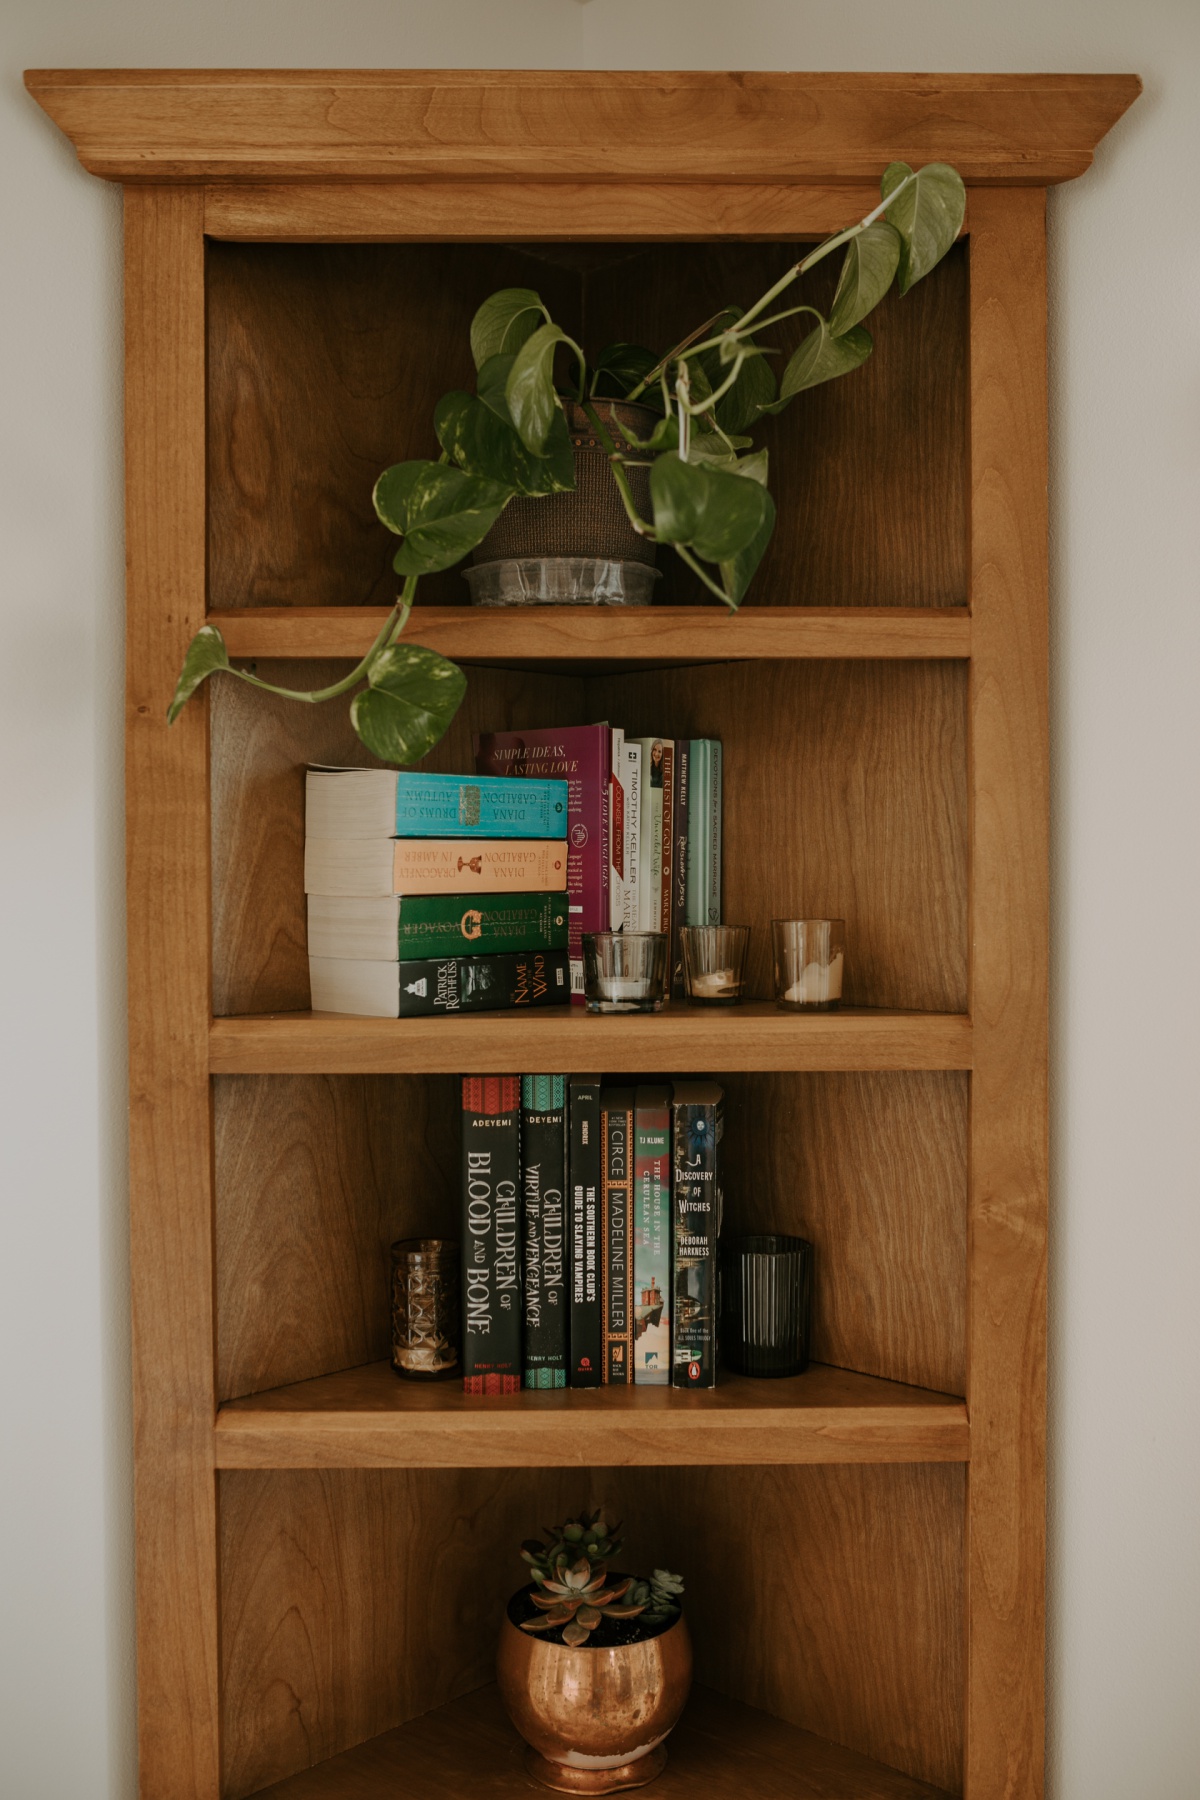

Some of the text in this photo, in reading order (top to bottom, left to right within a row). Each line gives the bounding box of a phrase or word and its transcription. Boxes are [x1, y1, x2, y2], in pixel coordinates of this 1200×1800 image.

[493, 745, 566, 760] SIMPLE IDEAS,
[505, 760, 579, 776] LASTING LOVE
[406, 790, 452, 801] AUTUMN
[484, 792, 537, 820] DIANA GABALDON
[630, 769, 638, 828] TIMOTHY
[403, 806, 456, 819] DRUMS OF
[664, 811, 670, 822] OF
[652, 814, 662, 856] Unveiled
[404, 852, 452, 862] IN AMBER
[485, 852, 536, 878] DIANA GABALDON
[650, 857, 661, 877] Wife
[399, 868, 456, 879] DRAGONFLY
[677, 836, 688, 907] Rediscover Jesus
[403, 921, 462, 935] VOYAGER
[482, 908, 537, 937] DIANA GABALDON
[434, 964, 448, 1006] PATRICK
[446, 961, 460, 1010] ROTHFUSS
[514, 962, 530, 1004] NAME
[533, 955, 548, 999] WIND
[612, 1131, 624, 1176] CIRCE
[686, 1154, 702, 1166] A
[676, 1169, 714, 1182] DISCOVERY
[693, 1187, 702, 1197] OF
[679, 1200, 711, 1214] WITCHES
[654, 1220, 660, 1231] IN
[466, 1152, 492, 1334] BLOOD AND BONE
[494, 1180, 518, 1310] CHILDREN OF
[526, 1163, 541, 1328] VIRTUE AND VENGEANCE
[542, 1188, 564, 1306] CHILDREN OF
[574, 1186, 584, 1304] GUIDE TO SLAYING VAMPIRES
[586, 1186, 596, 1302] THE SOUTHERN BOOK CLUB'S
[680, 1236, 708, 1245] DEBORAH
[680, 1247, 710, 1256] HARKNESS
[612, 1192, 624, 1328] MADELINE MILLER
